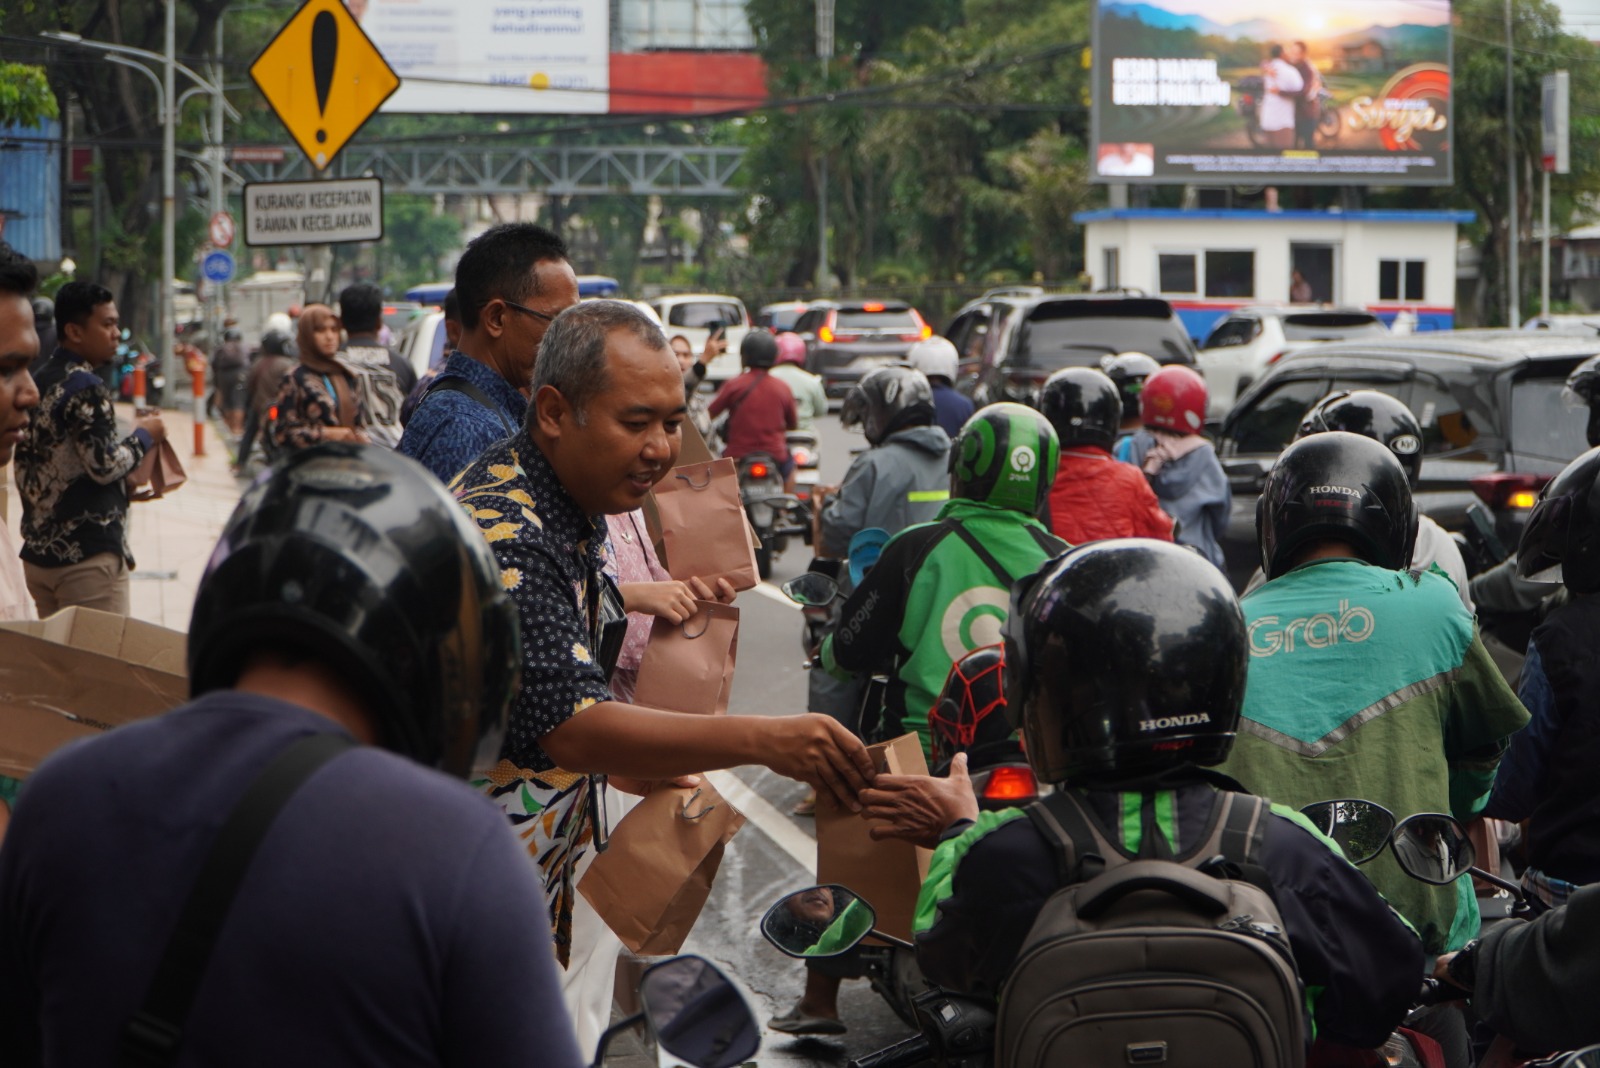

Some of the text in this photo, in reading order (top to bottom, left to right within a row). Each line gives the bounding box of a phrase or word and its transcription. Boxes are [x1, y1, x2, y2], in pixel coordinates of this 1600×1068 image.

[255, 190, 372, 210] KURANGI KECEPATAN
[255, 212, 372, 232] RAWAN KECELAKAAN
[1310, 485, 1361, 499] HONDA
[849, 589, 880, 634] gojek
[1247, 599, 1375, 658] Grab
[1139, 712, 1211, 731] HONDA
